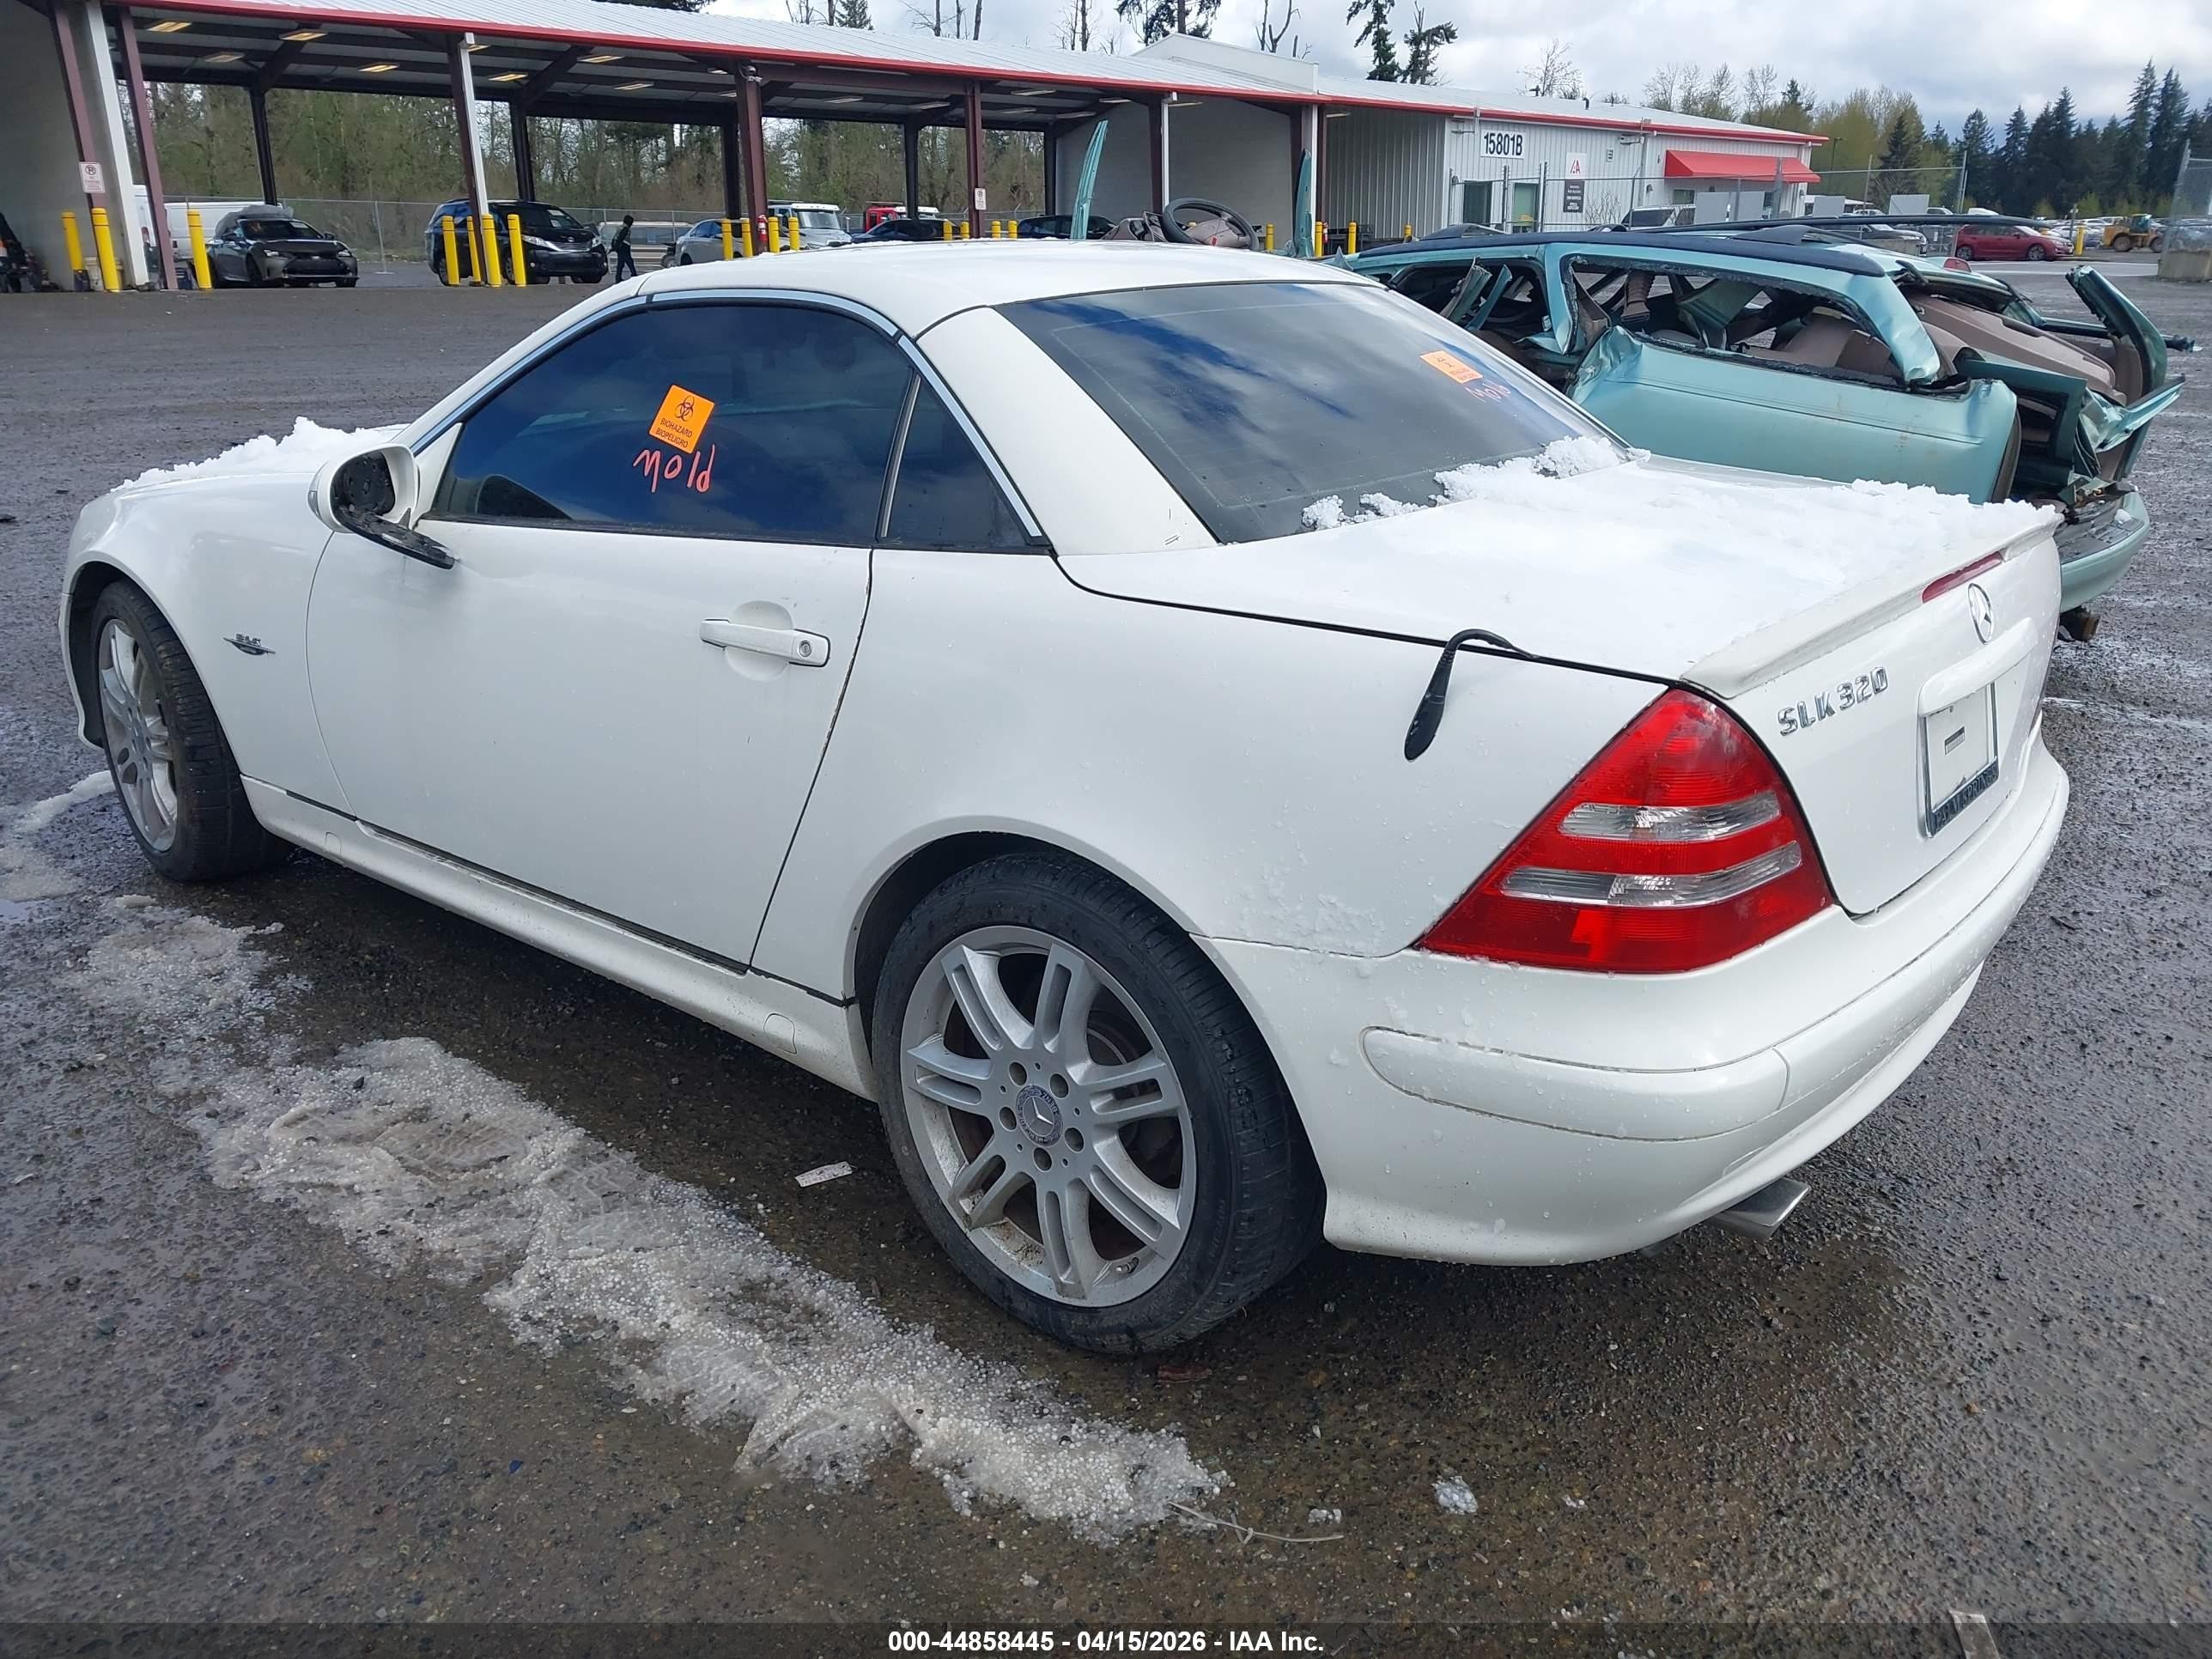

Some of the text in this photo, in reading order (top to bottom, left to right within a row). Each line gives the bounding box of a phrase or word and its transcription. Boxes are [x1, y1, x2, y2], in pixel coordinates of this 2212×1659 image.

[1484, 132, 1523, 155] 15801B
[655, 427, 689, 448] BIOPELIGRO
[659, 417, 693, 439] BIOHAZARD
[1777, 666, 1888, 737] SLK 320
